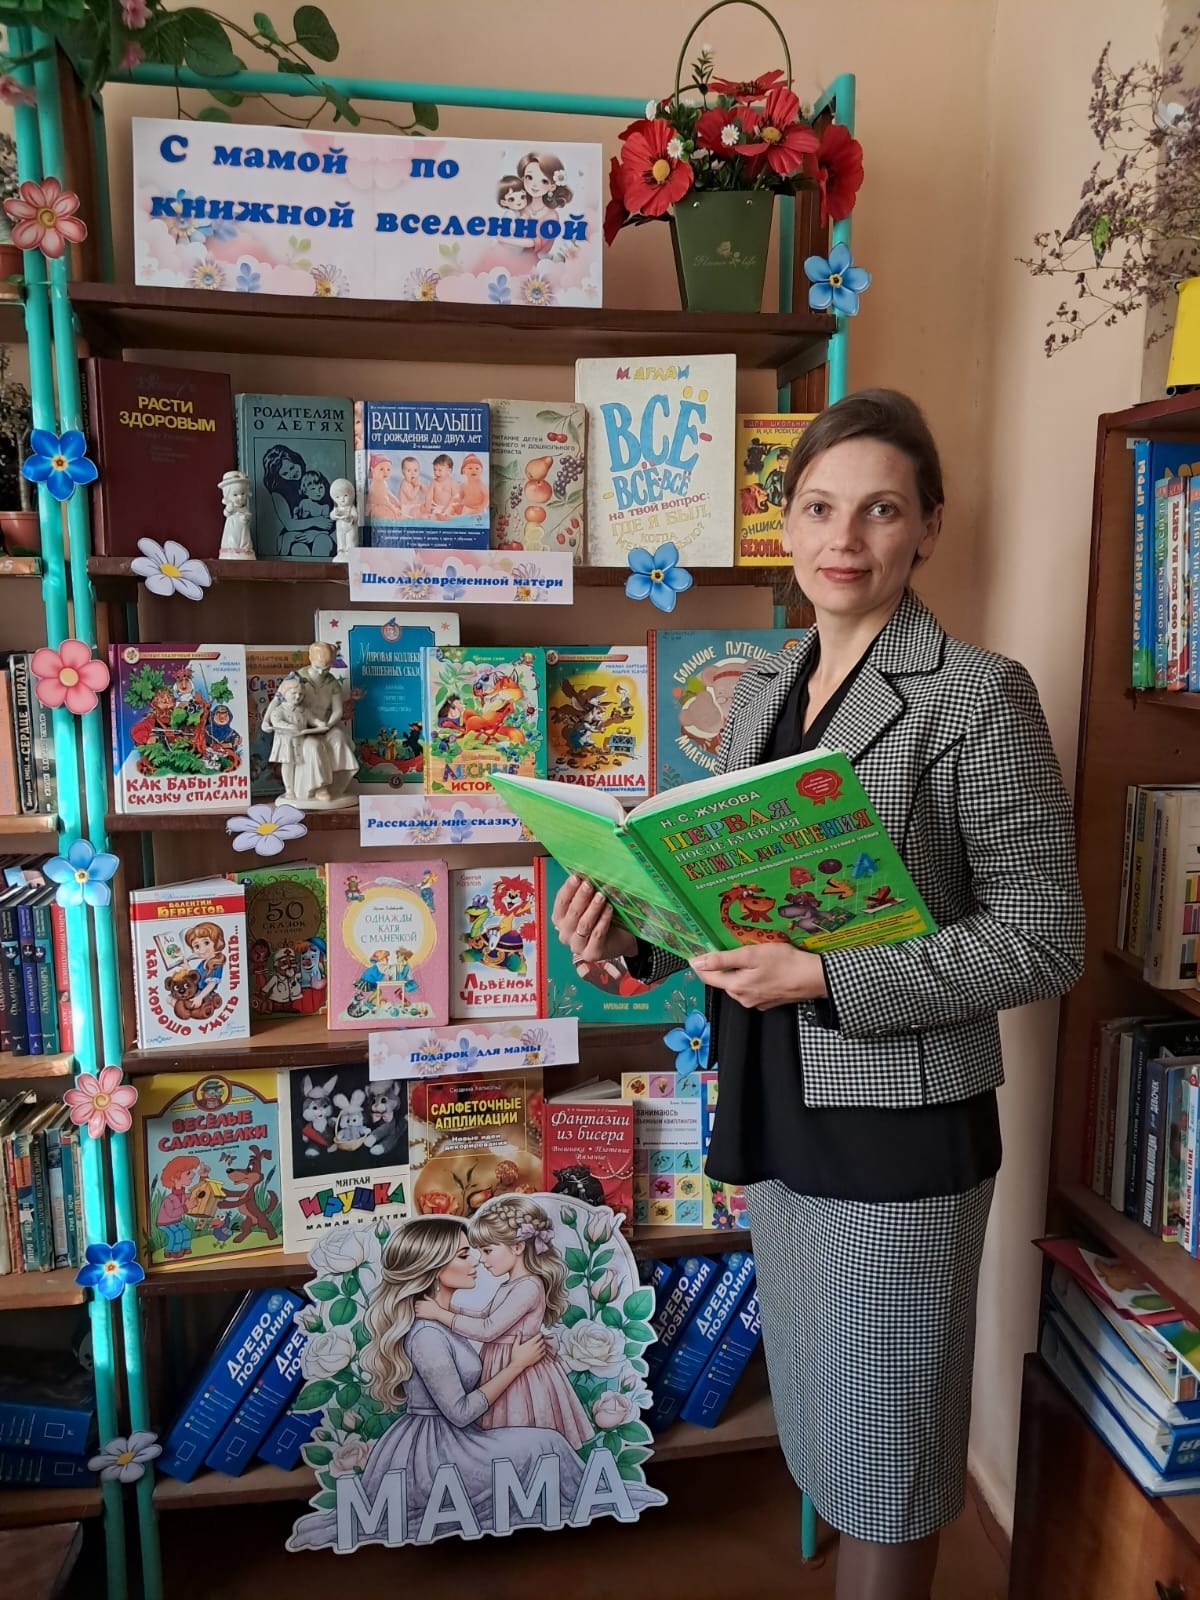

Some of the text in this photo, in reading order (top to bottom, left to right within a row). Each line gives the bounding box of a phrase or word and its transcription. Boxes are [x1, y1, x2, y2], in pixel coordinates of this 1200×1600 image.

[160, 134, 459, 179] С мамой по
[151, 196, 588, 241] книжной вселенной
[138, 396, 193, 414] РАСТИ
[253, 406, 344, 420] РОДИТЕЛЯМ
[119, 411, 216, 433] ЗДОРОВЫМ
[254, 420, 343, 432] О ДЕТЯХ
[372, 412, 409, 431] ВАШ
[415, 412, 481, 432] МАЛЫШ
[371, 433, 482, 446] от рождения до двух лет
[1136, 459, 1146, 506] ИГРЫ
[608, 511, 625, 522] на
[628, 503, 659, 517] твой
[1172, 501, 1180, 541] СВЕТЕ
[1172, 544, 1179, 563] НА
[361, 572, 564, 588] Школа современной матери
[673, 646, 717, 685] БОЛЬШОЕ
[16, 663, 27, 706] ПИРАТА
[19, 711, 30, 754] СЕРДЦЕ
[442, 762, 520, 783] ЛЕСНЫЕ
[127, 776, 248, 793] КАК БАБЫ-ЯГИ
[452, 782, 495, 791] ИСТОР
[128, 789, 248, 805] СКАЗКУ СПАСАЛИ
[660, 791, 760, 829] Н. С. ЖУКОВА
[367, 818, 438, 829] Расскажи
[441, 819, 467, 827] мне
[661, 798, 796, 853] ПЕРВАЯ
[675, 817, 800, 863] ПОСЛЕ БУКВАРЯ
[681, 848, 755, 881] КНИГА
[779, 808, 874, 850] ЧТЕНИЯ
[266, 901, 304, 922] 50
[365, 913, 413, 924] ОДНАЖДЫ
[361, 931, 417, 943] С МАНЕЧКОЙ
[378, 924, 400, 933] КАТЯ
[464, 973, 534, 990] ЛЬВЁНОК
[459, 990, 537, 1006] ЧЕРЕПАХА
[410, 1044, 542, 1063] Подарок для мамы
[431, 1097, 522, 1116] САЛФЕТОЧНЫЕ
[1150, 1080, 1160, 1114] ДЕВОЧЕК
[172, 1110, 252, 1134] ВЕСЁЛЫЕ
[435, 1111, 518, 1130] АППЛИКАЦИИ
[551, 1110, 631, 1127] Фантазии
[158, 1125, 268, 1153] САМОДЕЛКИ
[557, 1125, 625, 1147] из бисера
[336, 1176, 370, 1187] МЯГКАЯ
[298, 1182, 406, 1219] ИГРУШКА
[306, 1220, 349, 1230] МАМАМ
[372, 1213, 407, 1222] ДЕТЯМ
[653, 1276, 689, 1337] ДРЕВО
[661, 1263, 710, 1346] ПОЗНАНИЯ
[696, 1271, 733, 1336] ДРЕВО
[706, 1257, 754, 1341] ПОЗНАНИЯ
[227, 1312, 271, 1380] ДРЕВО
[235, 1300, 294, 1386] ПОЗНАНИЯ
[275, 1329, 307, 1375] ДРЕ
[336, 1447, 637, 1551] МАМА
